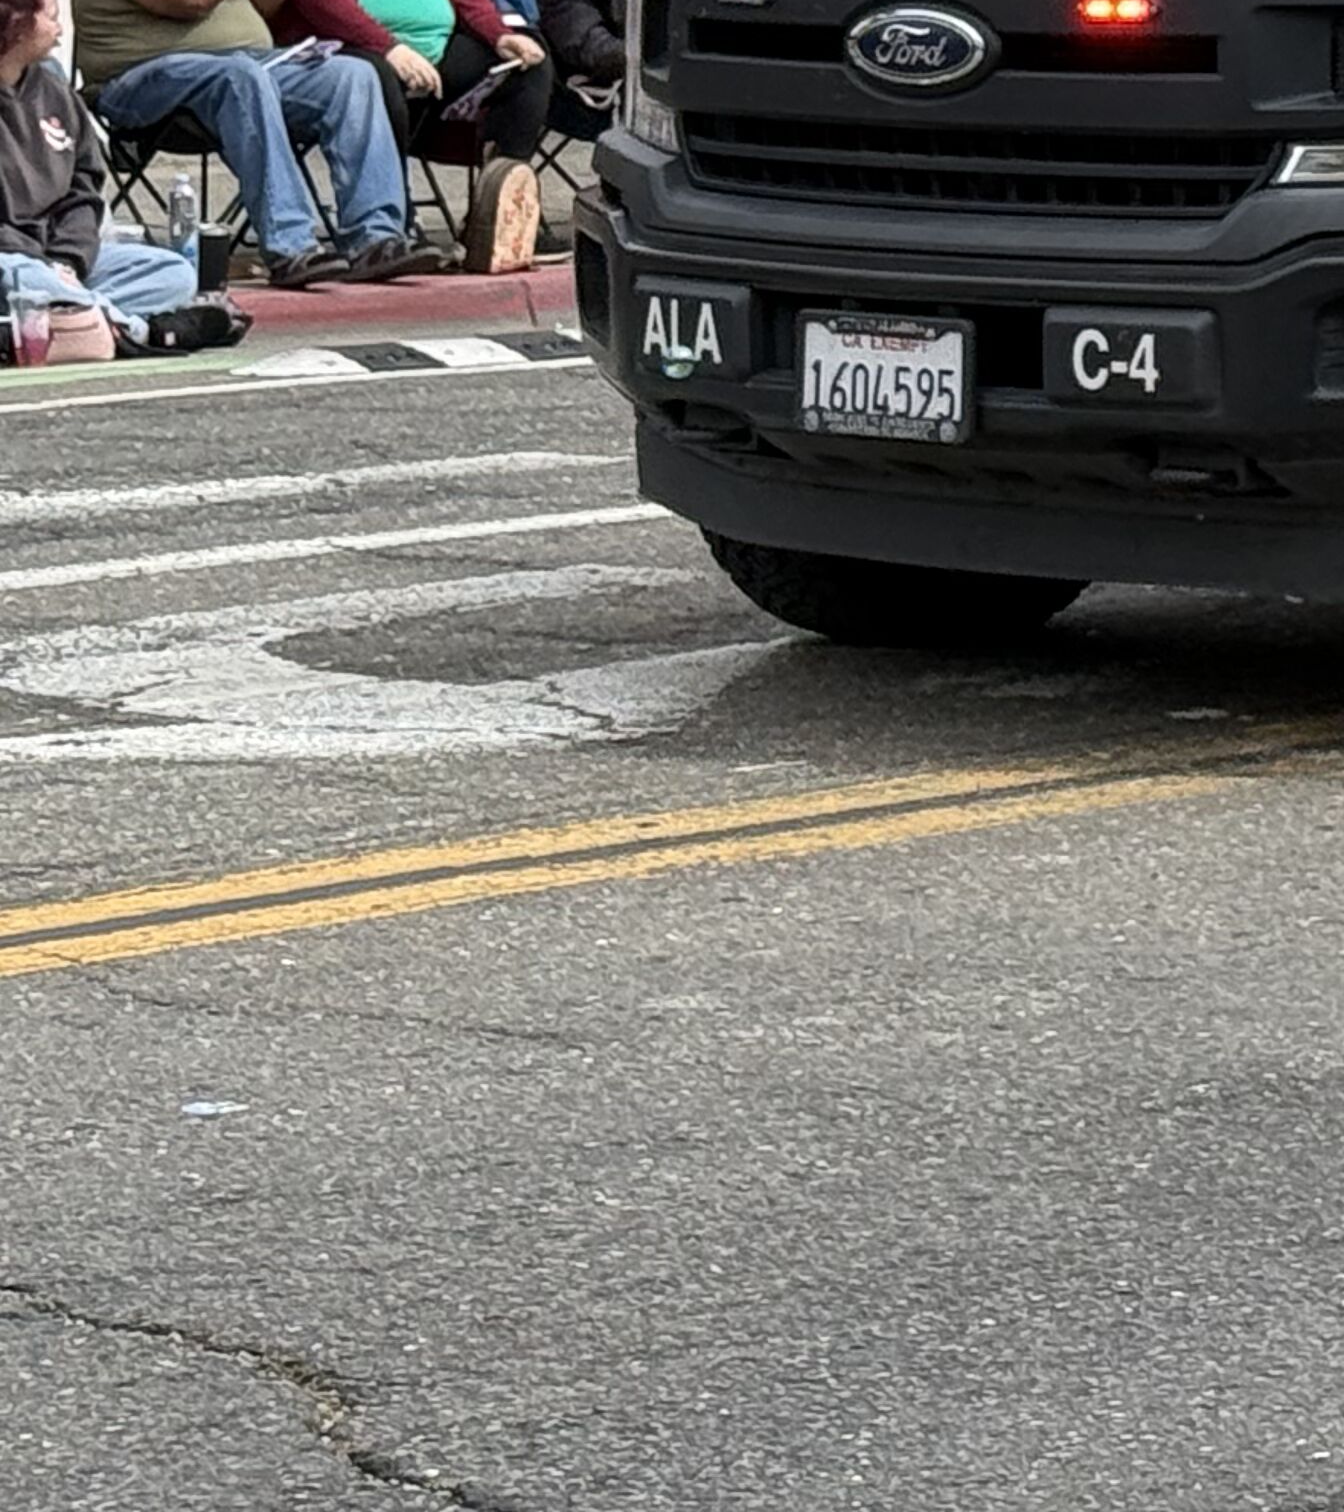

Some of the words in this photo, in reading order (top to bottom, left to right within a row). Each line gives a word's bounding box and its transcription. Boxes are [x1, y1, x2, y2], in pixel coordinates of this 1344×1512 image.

[875, 23, 948, 67] Ford
[643, 296, 722, 365] ALA
[1072, 328, 1160, 393] C-4
[812, 359, 955, 420] 1604595
